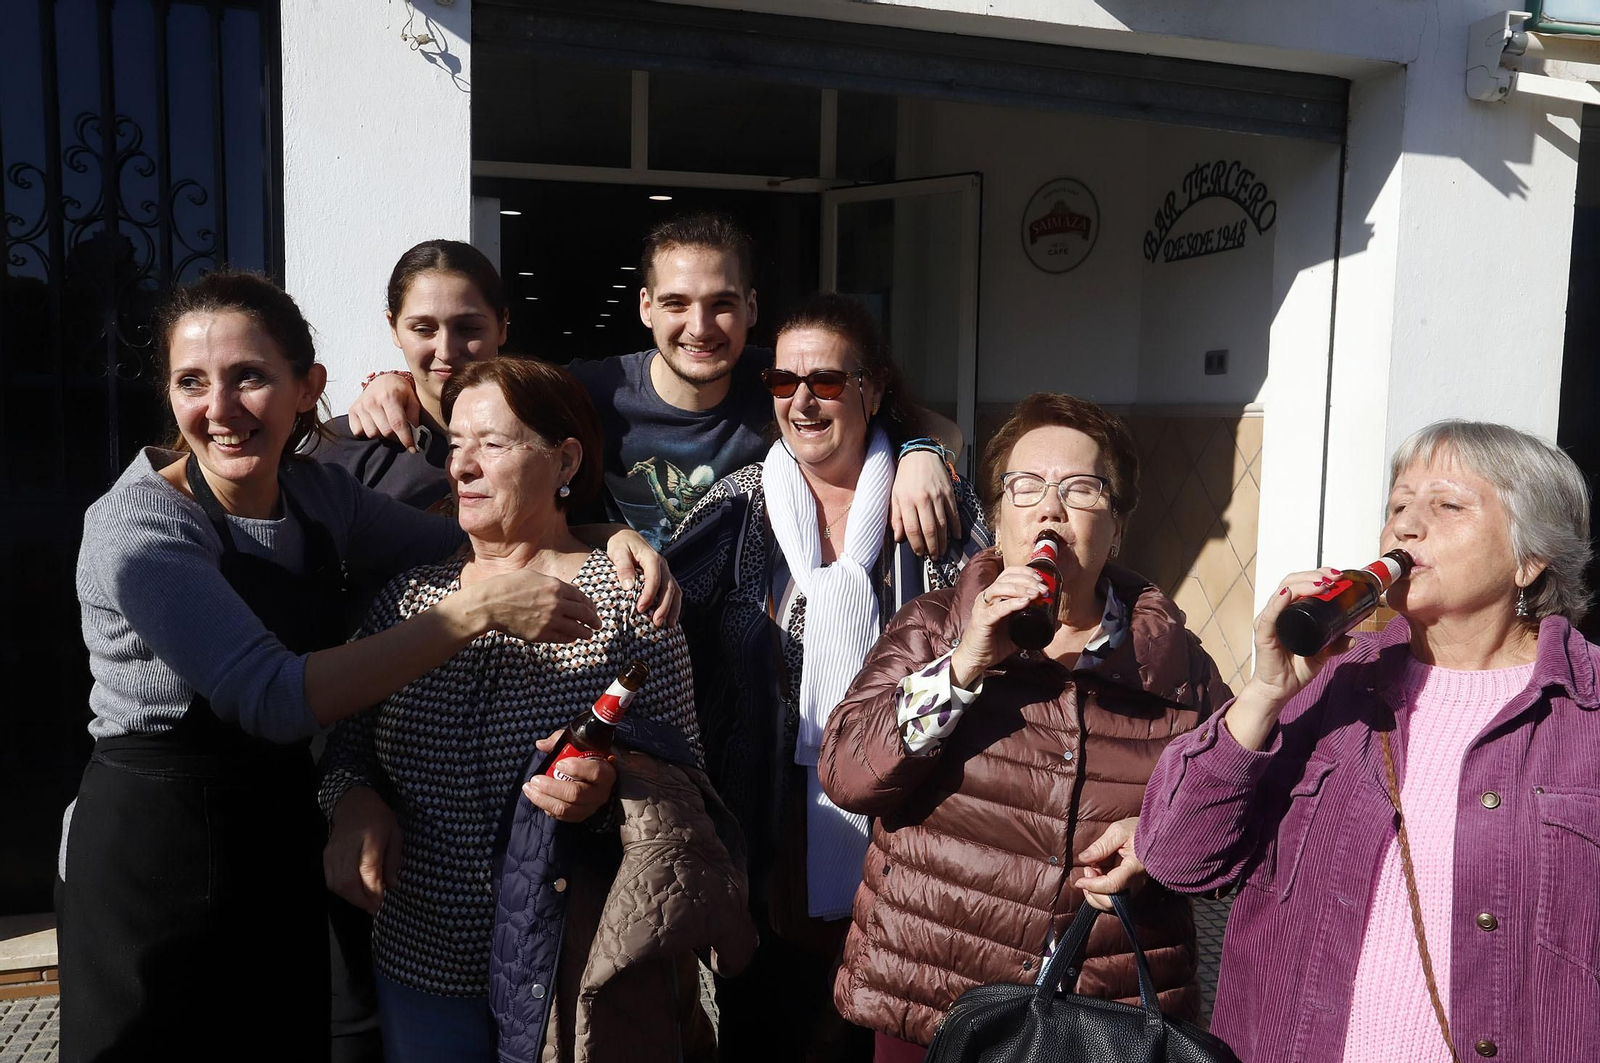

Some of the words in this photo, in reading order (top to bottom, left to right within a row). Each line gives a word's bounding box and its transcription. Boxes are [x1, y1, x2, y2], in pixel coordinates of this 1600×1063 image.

[1032, 216, 1086, 234] SAIMAZA
[1143, 190, 1182, 263] BAR
[1183, 160, 1277, 233] TERCERO
[1163, 229, 1214, 262] DESDE
[1217, 219, 1247, 250] 1948
